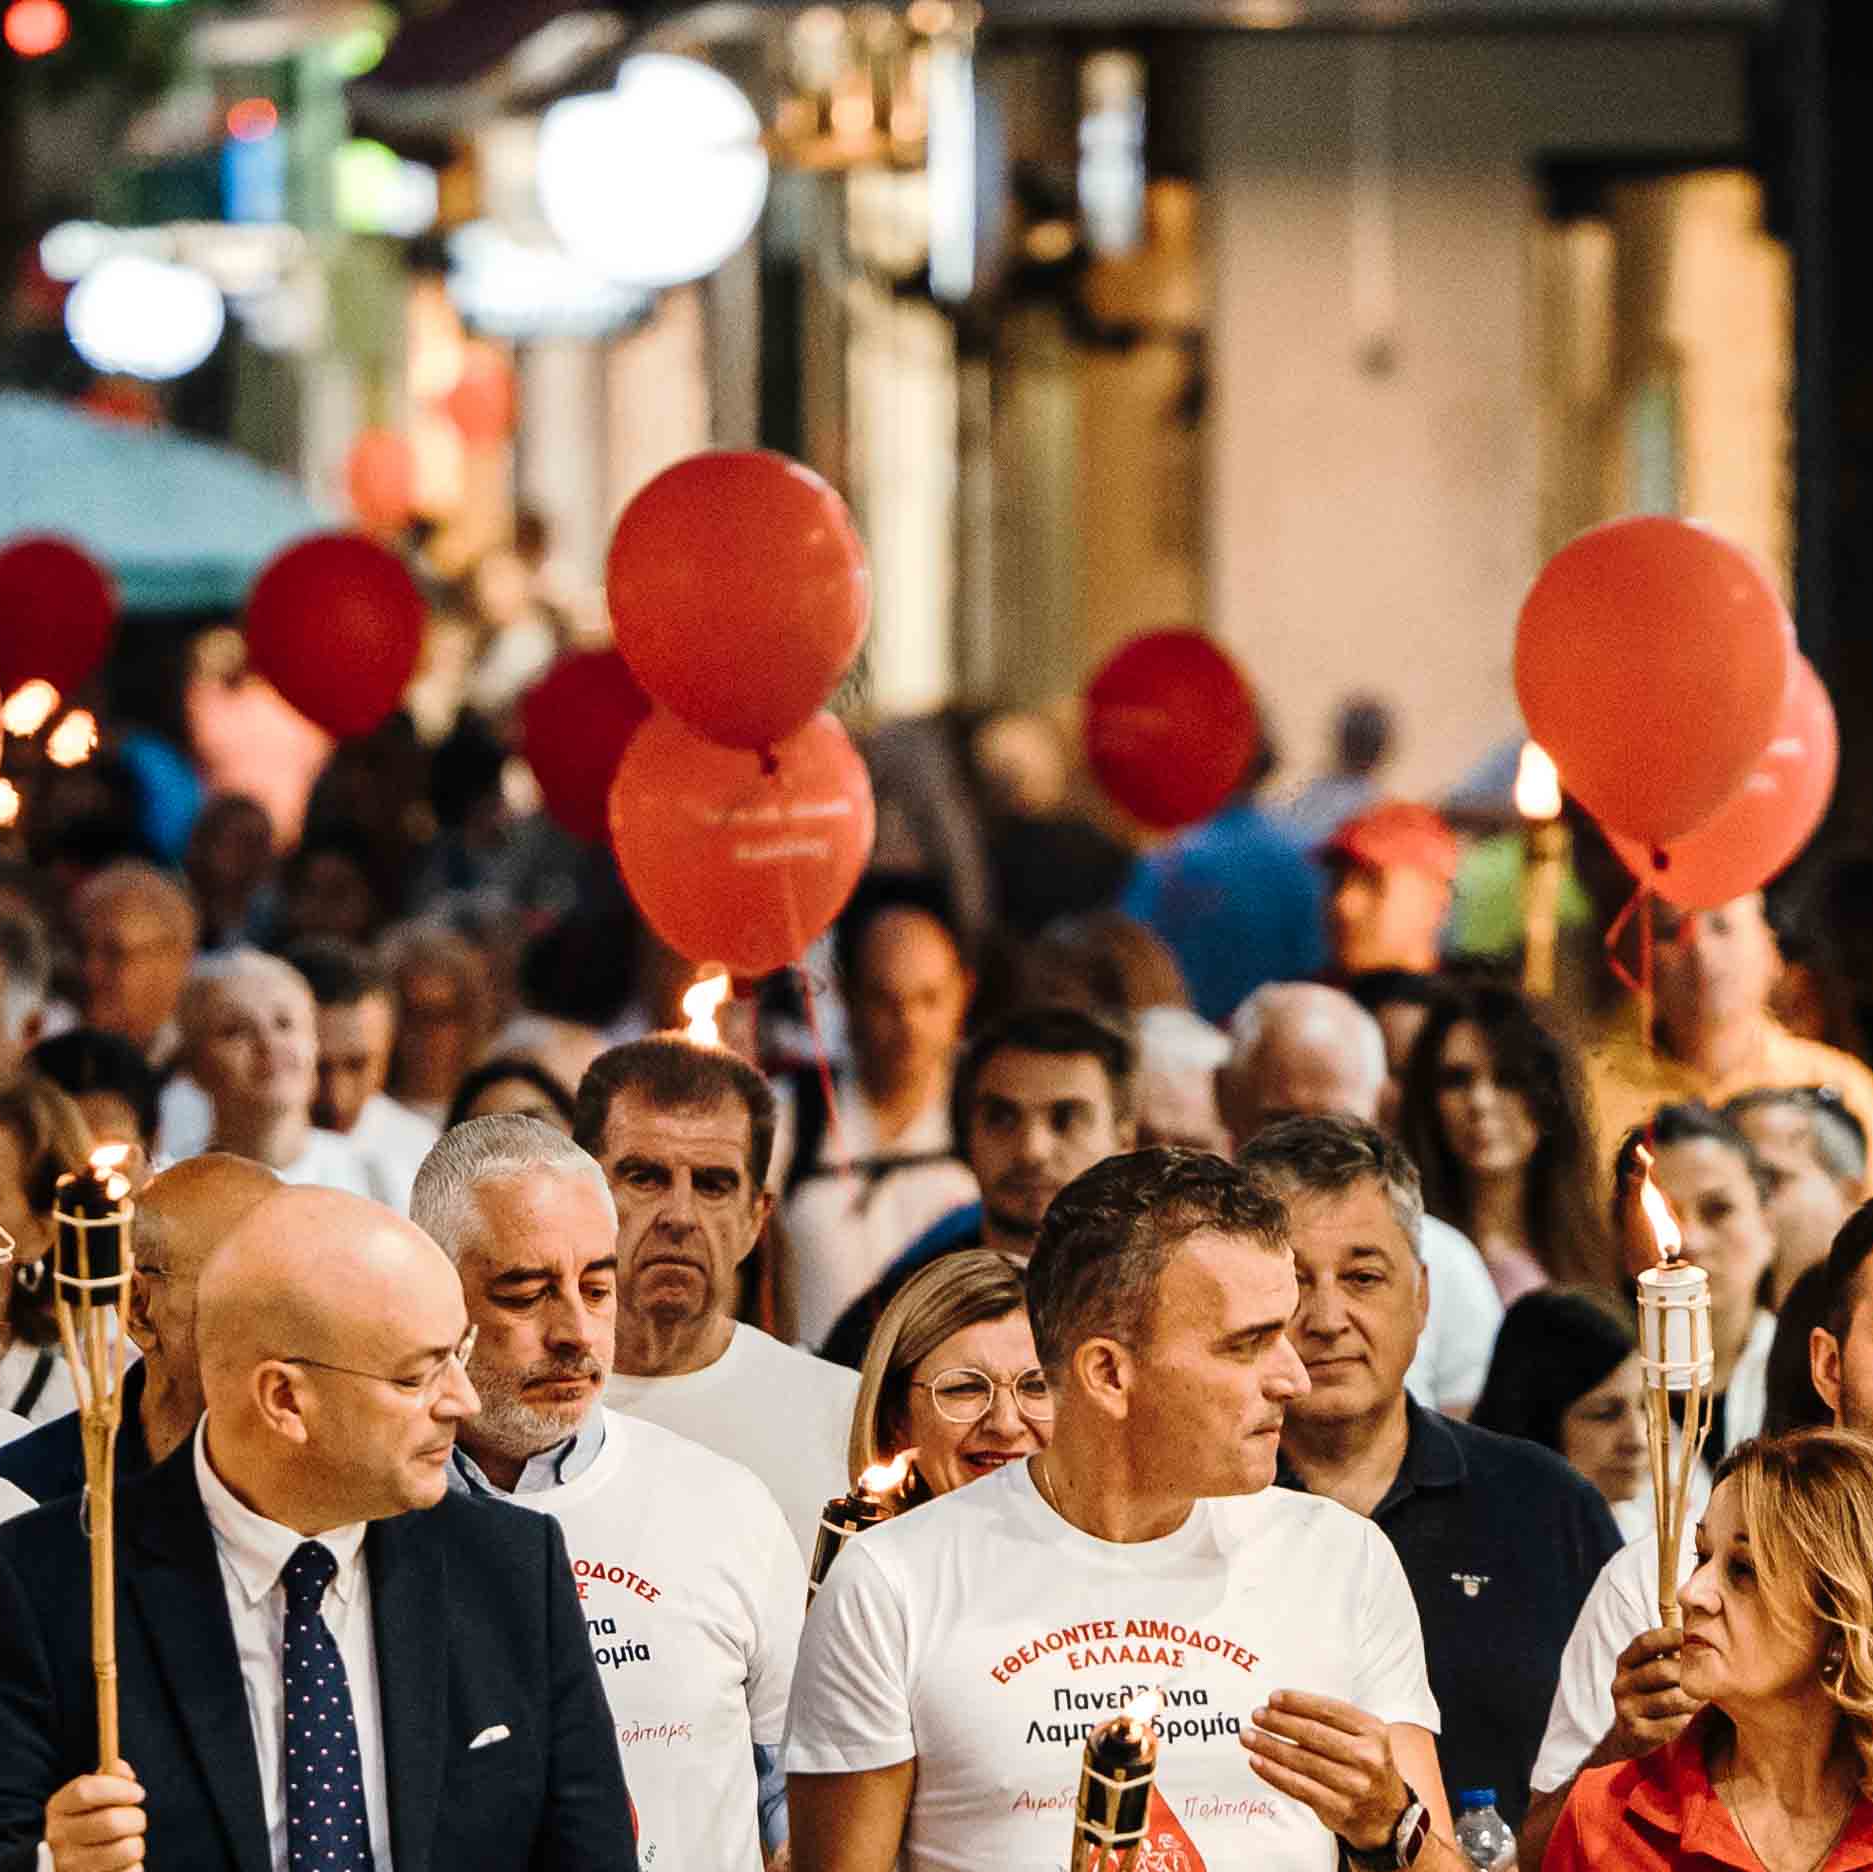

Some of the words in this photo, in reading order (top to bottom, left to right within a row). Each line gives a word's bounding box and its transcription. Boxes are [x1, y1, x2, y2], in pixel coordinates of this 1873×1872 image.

[573, 1559, 662, 1605] ΟΔΟΤΕΣ
[990, 1620, 1118, 1685] ΕΘΕΛΟΝΤΕΣ
[1124, 1619, 1260, 1673] ΑΙΜΟΔΟΤΕΣ
[1067, 1645, 1186, 1672] ΕΛΛΑΔΑΣ
[615, 1720, 694, 1752] ολιτισμός
[1025, 1713, 1242, 1747] Λαμπδρομία
